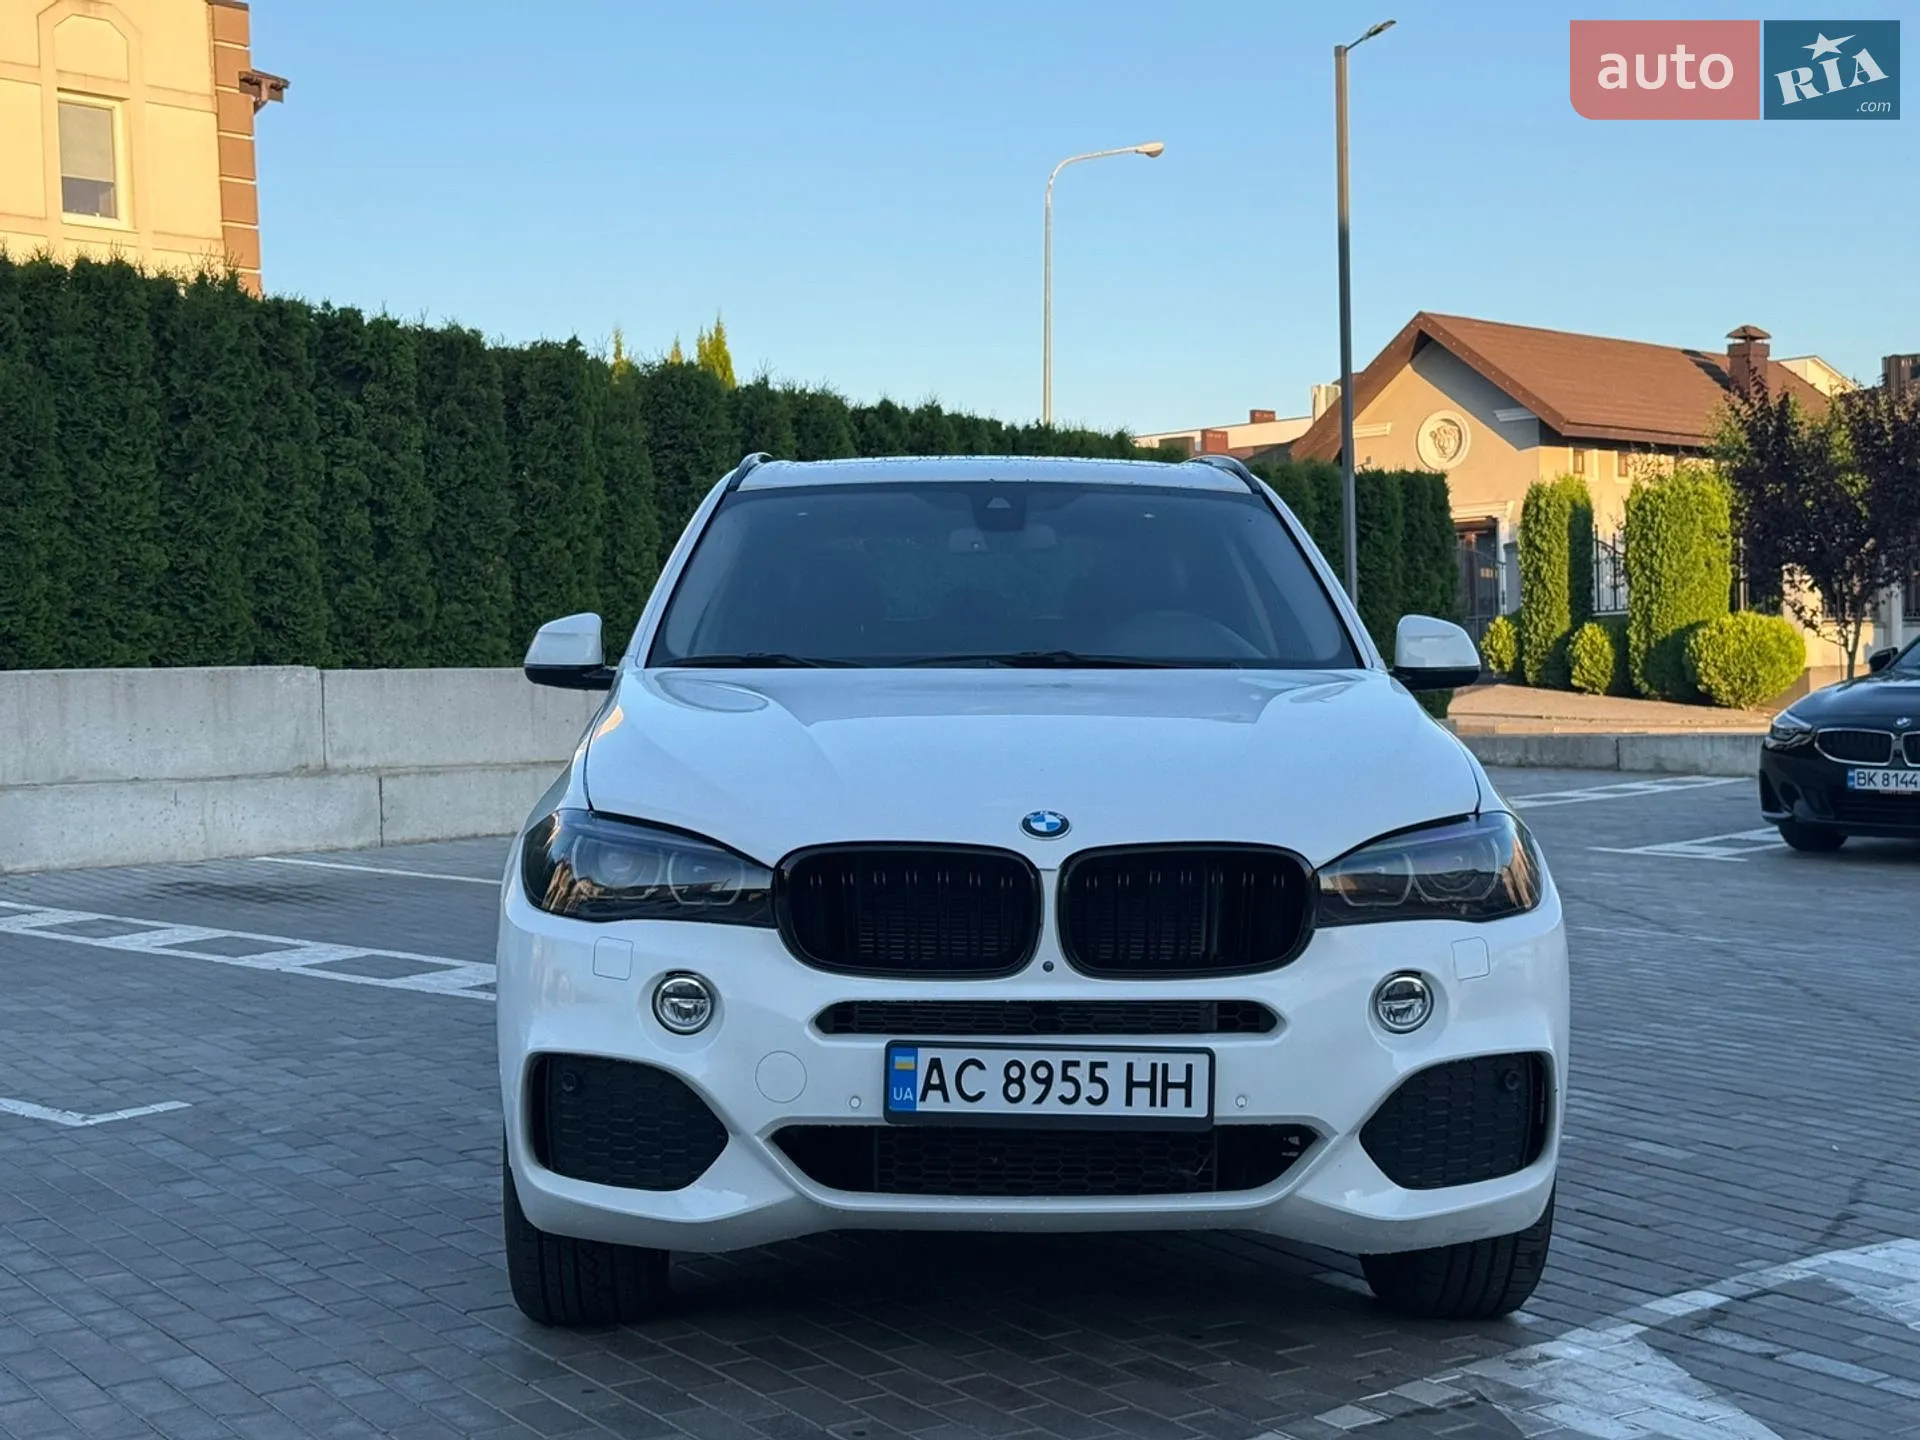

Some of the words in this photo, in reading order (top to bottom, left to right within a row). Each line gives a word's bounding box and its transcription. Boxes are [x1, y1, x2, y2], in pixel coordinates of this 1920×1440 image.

[1857, 771, 1877, 787] BK
[1881, 772, 1918, 788] 8144
[919, 1057, 987, 1103] AC
[1002, 1059, 1110, 1107] 8955
[1124, 1061, 1193, 1108] HH
[893, 1087, 914, 1102] UA
